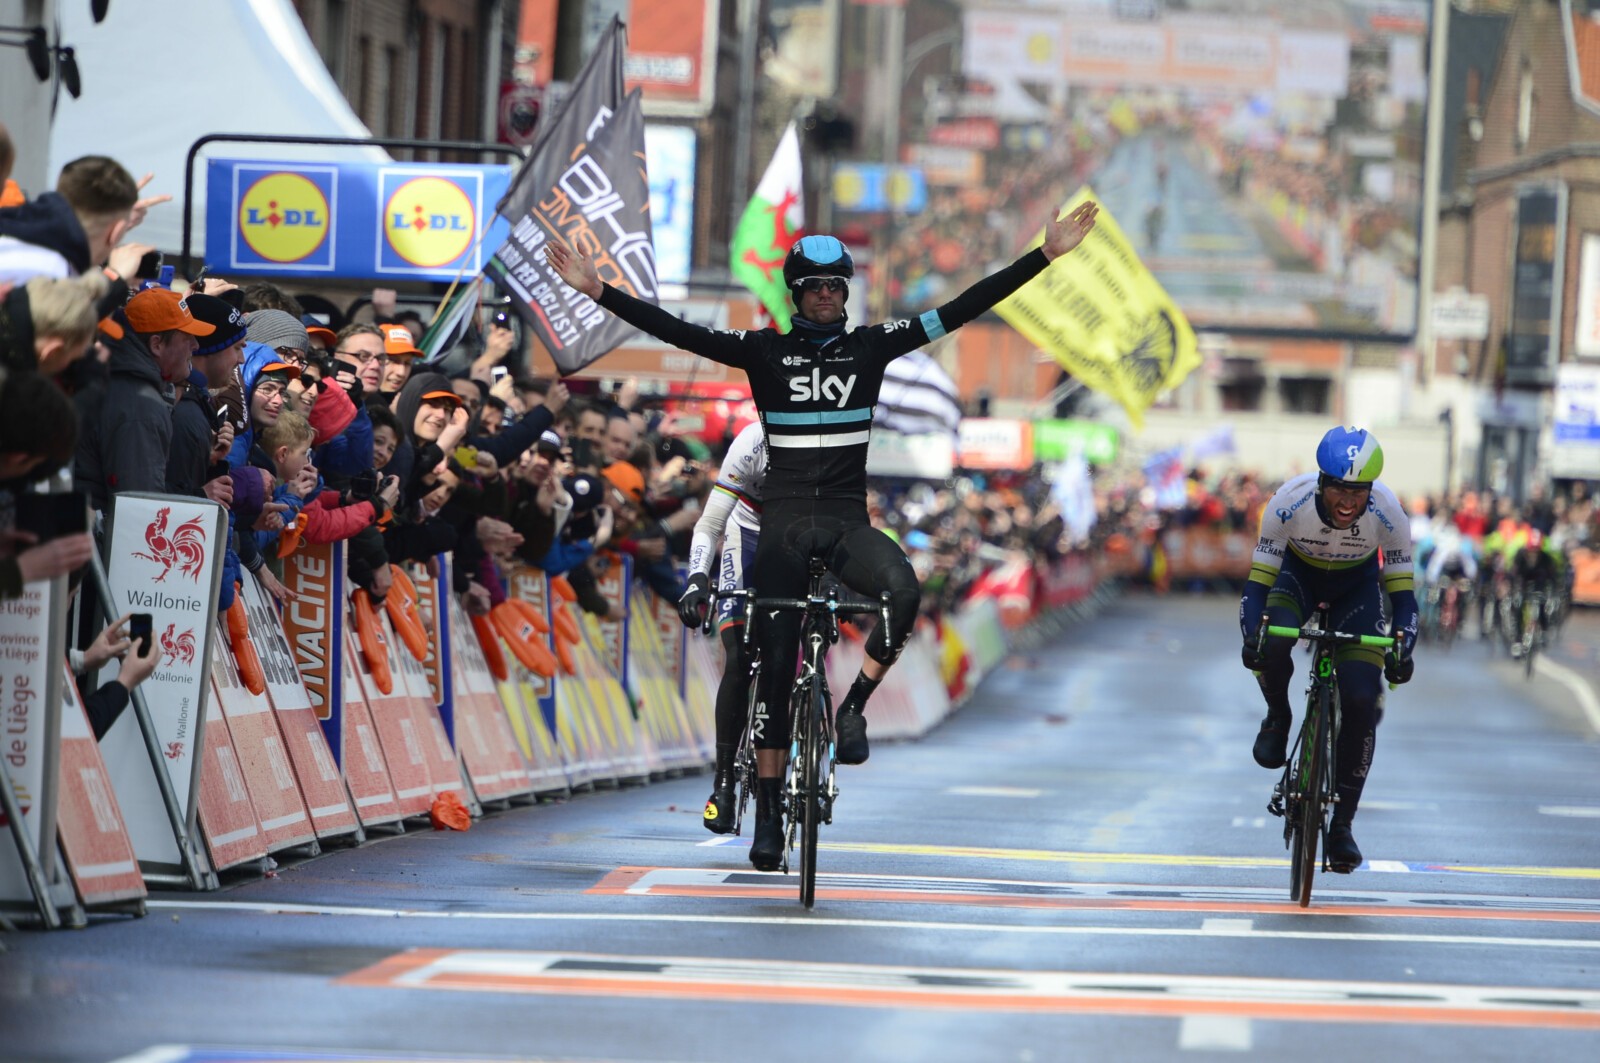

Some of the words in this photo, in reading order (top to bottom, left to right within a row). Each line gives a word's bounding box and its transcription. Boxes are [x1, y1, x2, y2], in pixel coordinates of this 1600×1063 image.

[559, 154, 656, 298] BIKE
[514, 260, 540, 288] PER
[531, 275, 581, 347] CICLISTI
[789, 368, 857, 408] sky
[1290, 491, 1314, 512] ORICA
[1375, 508, 1395, 533] ORICA
[1260, 536, 1274, 547] BIKE
[127, 590, 202, 612] Wallonie
[150, 670, 193, 685] Wallonie
[176, 696, 189, 740] Wallonie
[754, 701, 770, 740] sky
